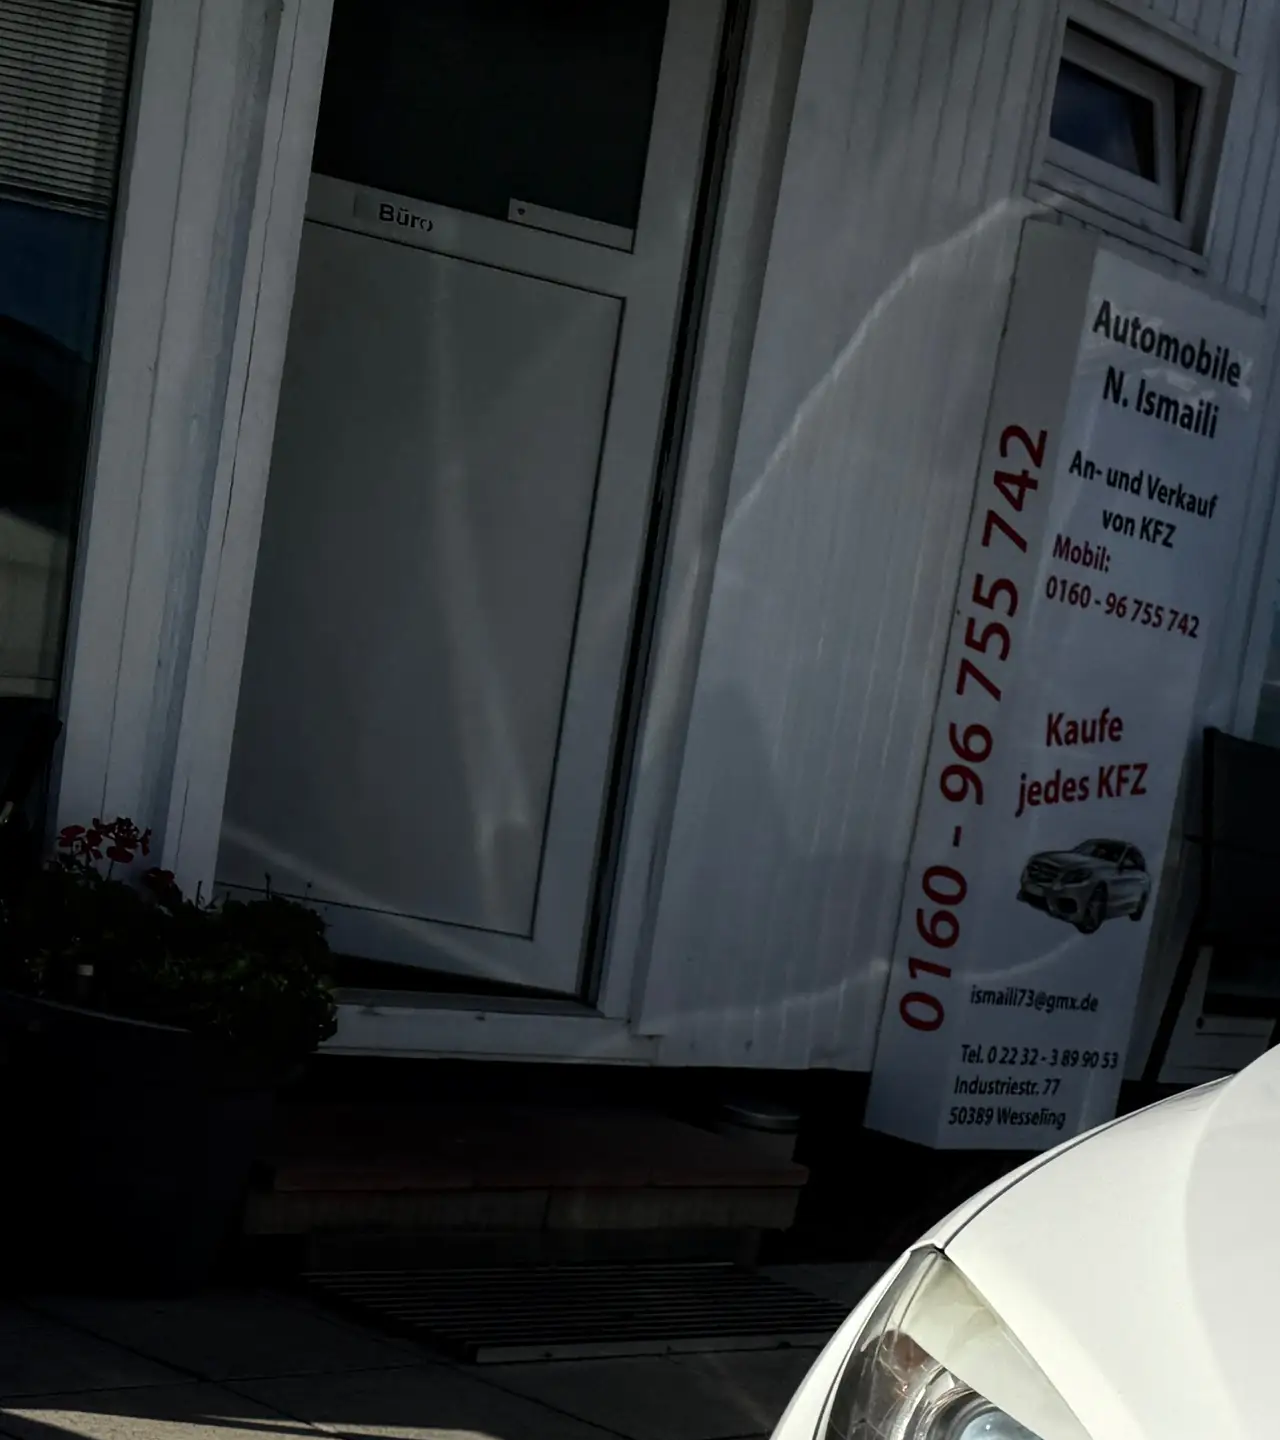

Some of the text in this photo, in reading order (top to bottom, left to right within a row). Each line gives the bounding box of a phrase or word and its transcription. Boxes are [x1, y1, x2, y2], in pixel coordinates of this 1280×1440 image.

[379, 203, 433, 232] Büro
[1093, 300, 1241, 387] Automobile
[1103, 365, 1220, 438] N. Ismaili
[982, 425, 1047, 553] 742
[1069, 450, 1219, 519] An- und Verkauf
[1053, 534, 1110, 573] Mobil:
[1103, 510, 1177, 548] von KFZ
[1046, 575, 1091, 609] 0160
[1105, 593, 1128, 618] 96
[1131, 599, 1164, 628] 755
[1168, 609, 1200, 638] 742
[956, 573, 1019, 702] 755
[1046, 707, 1123, 747] Kaufe
[940, 723, 993, 805] 96
[1015, 763, 1148, 818] jedes KFZ
[900, 865, 967, 1032] 0160
[971, 984, 1098, 1014] ismaili73@gmx.de
[962, 1044, 984, 1064] Tel.
[988, 1046, 997, 1064] 0
[999, 1047, 1018, 1065] 22
[1020, 1048, 1038, 1066] 32
[1049, 1049, 1059, 1066] 3
[1061, 1050, 1079, 1067] 89
[1082, 1051, 1099, 1068] 90
[1101, 1052, 1118, 1069] 53
[954, 1075, 1061, 1096] Industriestr. 77
[949, 1106, 1066, 1130] 50389 Wesseling
